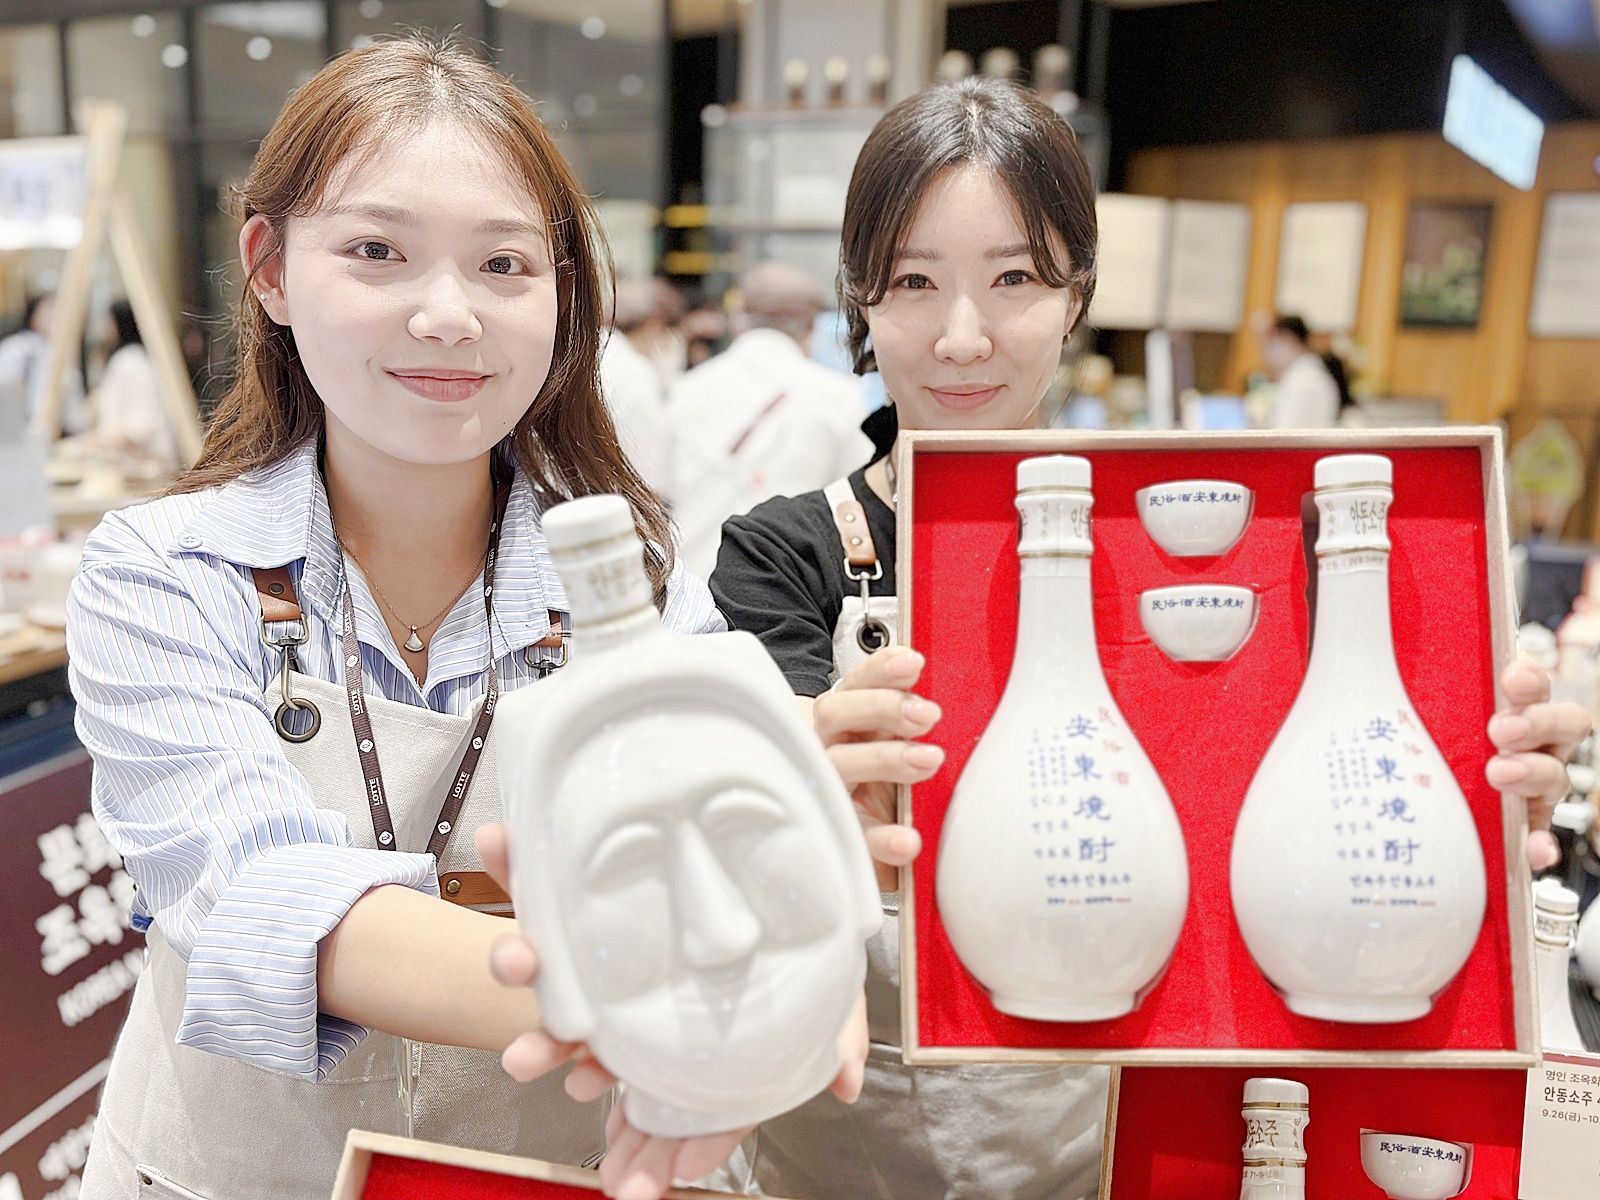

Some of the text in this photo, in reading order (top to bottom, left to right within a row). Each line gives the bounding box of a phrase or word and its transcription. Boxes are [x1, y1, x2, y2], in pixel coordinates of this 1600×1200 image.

[485, 690, 497, 715] LOTTE
[369, 778, 380, 806] LOTTE
[452, 771, 467, 799] LOTTE
[1546, 1070, 1567, 1082] 명인
[1544, 1086, 1593, 1106] 안동소주
